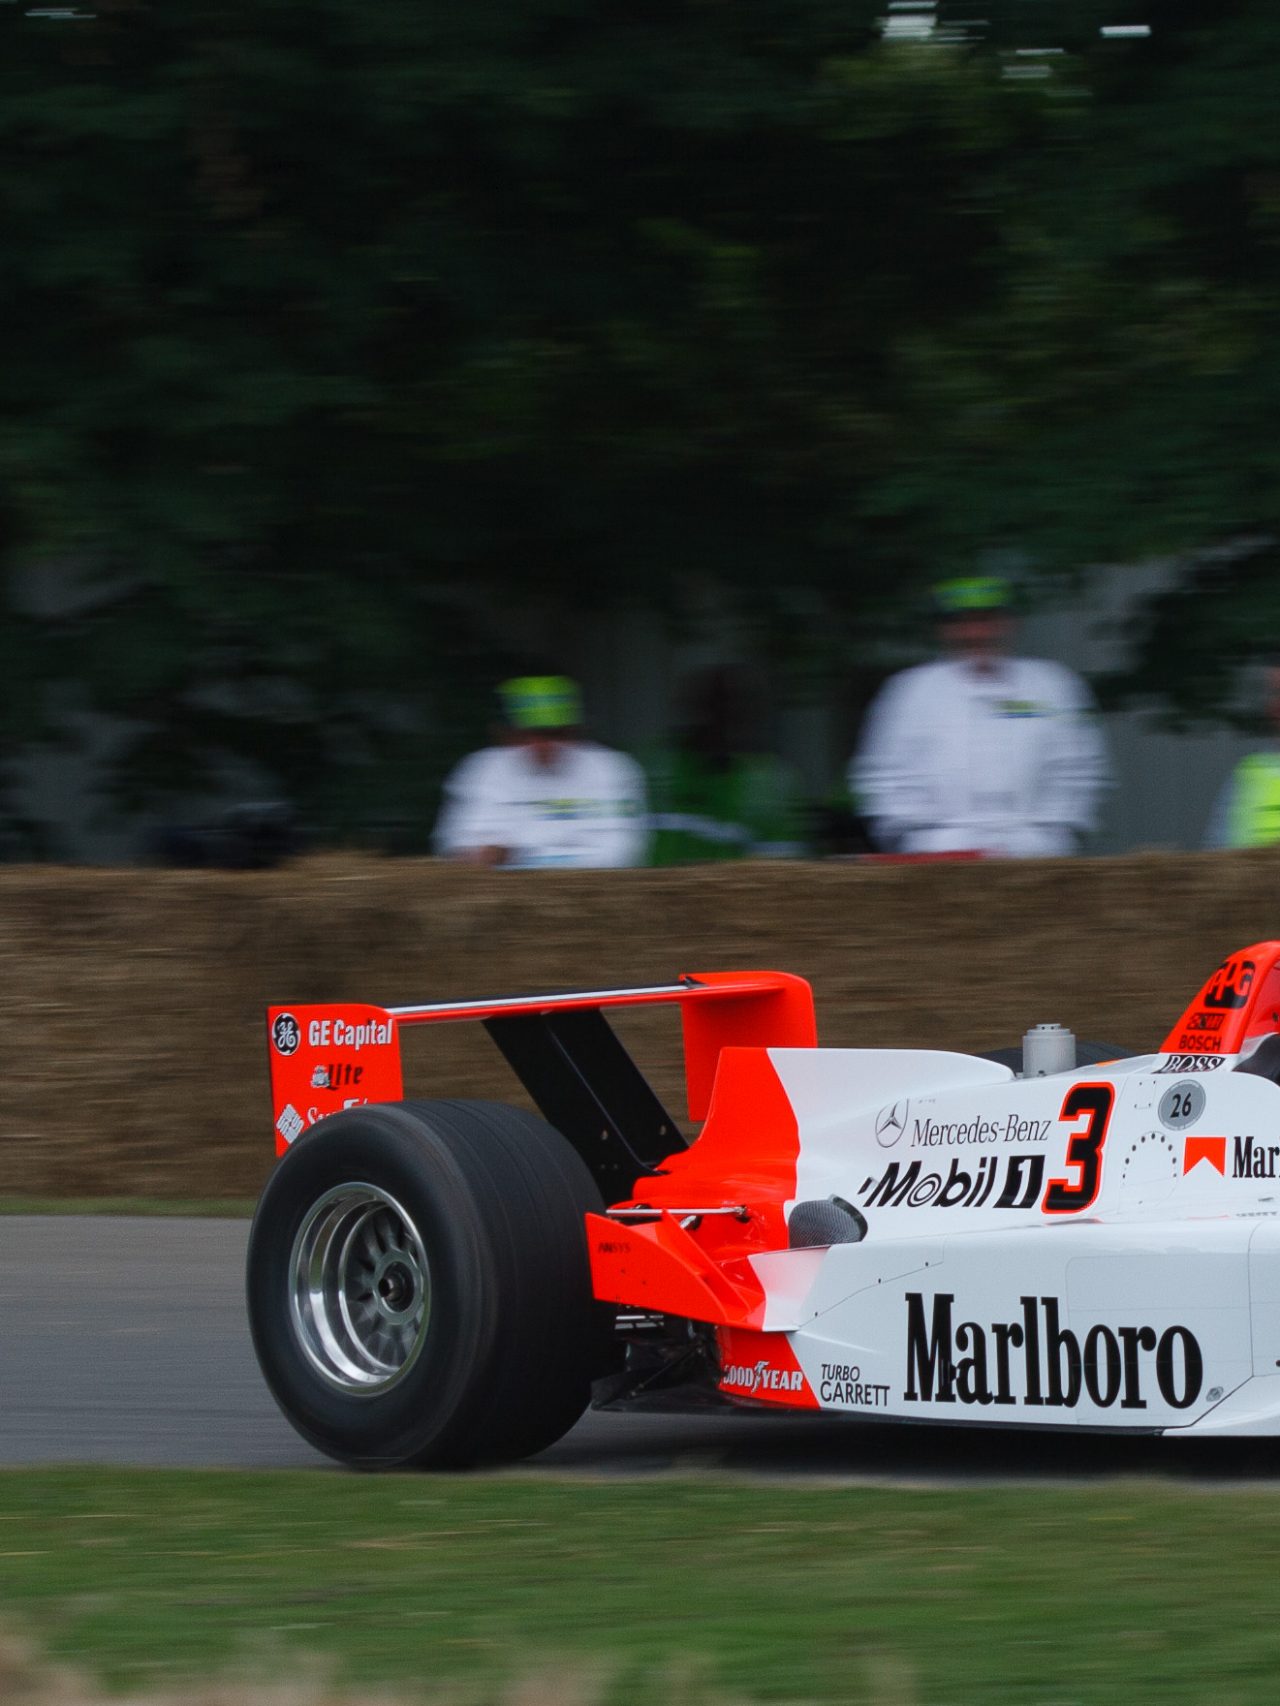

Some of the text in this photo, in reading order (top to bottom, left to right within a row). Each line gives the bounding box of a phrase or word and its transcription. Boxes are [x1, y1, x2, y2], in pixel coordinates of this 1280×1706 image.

[308, 1018, 393, 1050] GE Capital
[1179, 1035, 1221, 1050] BOSCH
[326, 1064, 363, 1090] Lite
[1161, 1055, 1222, 1073] BOSS
[1170, 1093, 1192, 1118] 26
[911, 1114, 1051, 1147] Mercedes-Benz
[1041, 1081, 1116, 1214] 3
[858, 1156, 1040, 1208] Mobil 1
[904, 1292, 1203, 1410] Marlboro
[821, 1364, 860, 1382] TURBO
[820, 1381, 890, 1406] GARRETT
